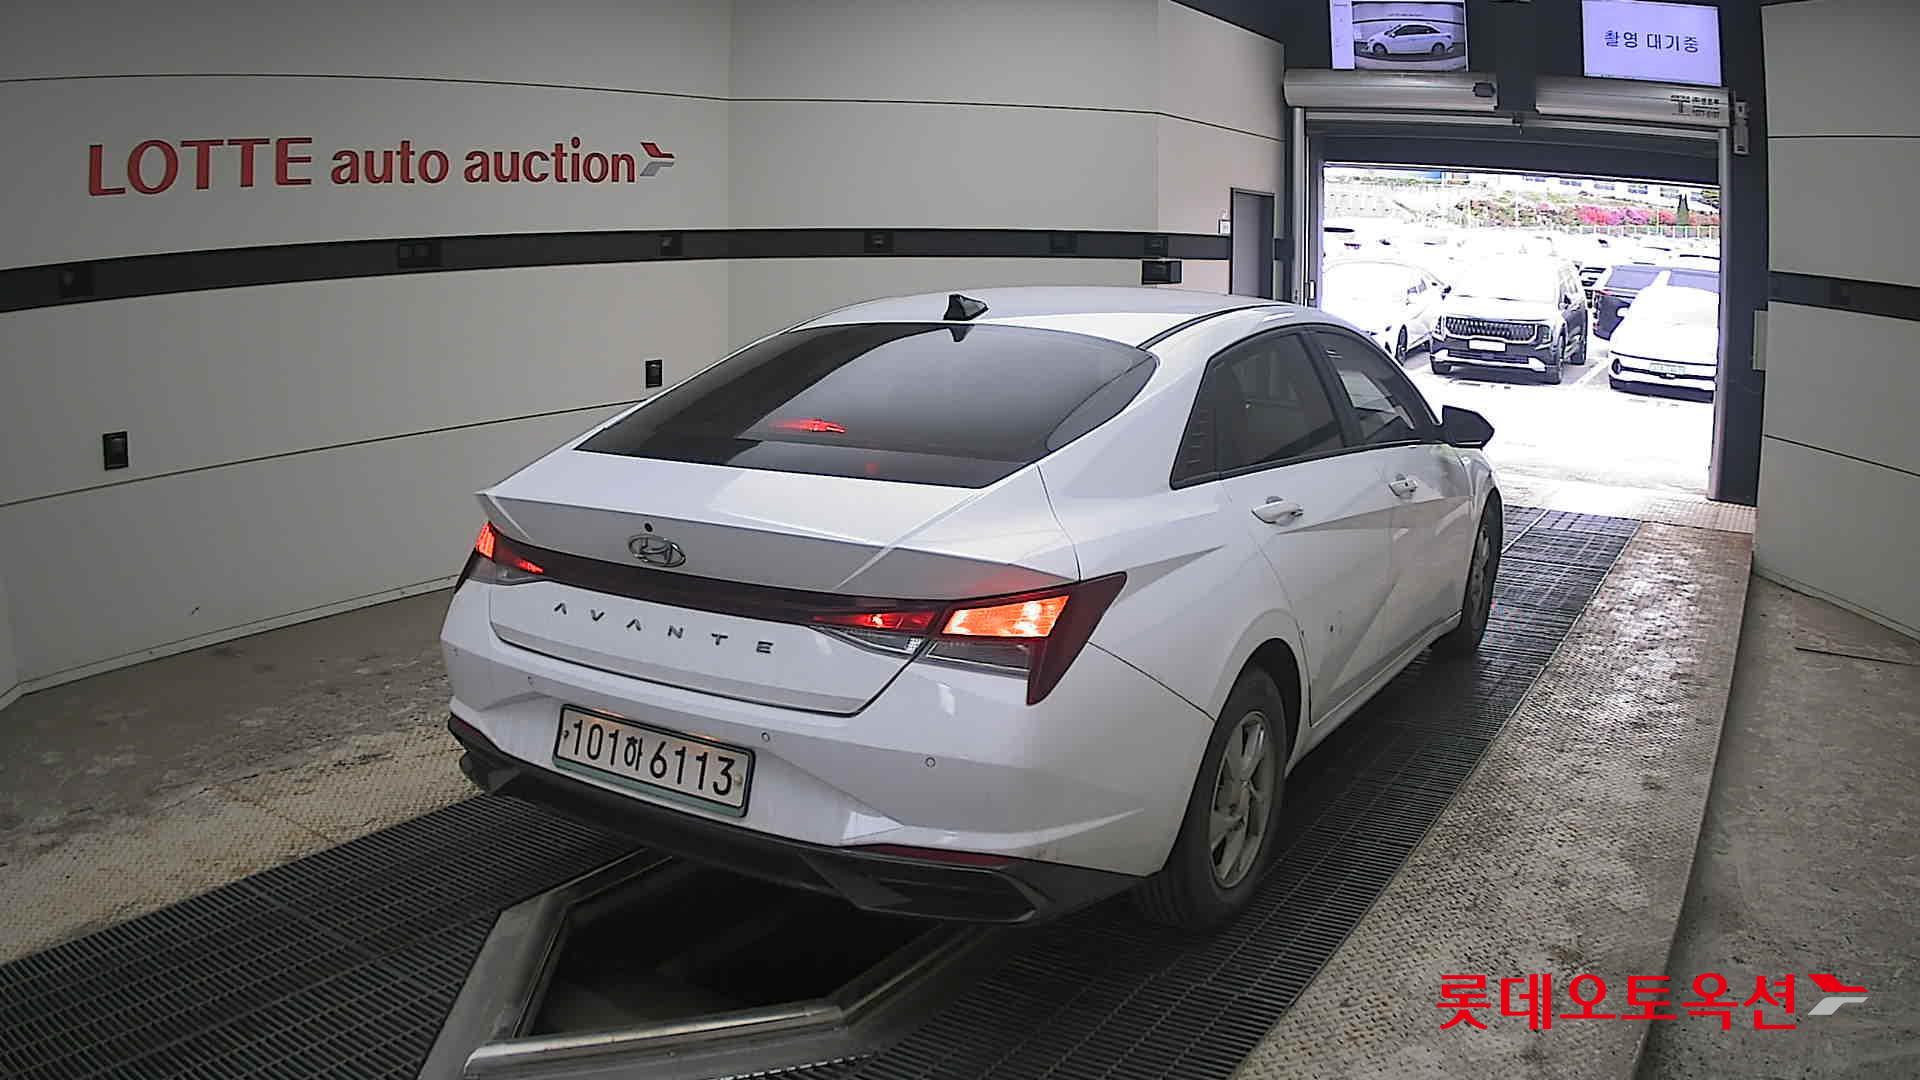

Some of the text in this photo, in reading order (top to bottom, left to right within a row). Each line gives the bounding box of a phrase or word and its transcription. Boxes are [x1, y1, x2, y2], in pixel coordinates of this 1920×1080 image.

[1603, 30, 1699, 54] 촬영 대기중
[88, 136, 636, 197] LOTTE auto auction
[553, 601, 774, 655] AVANTE
